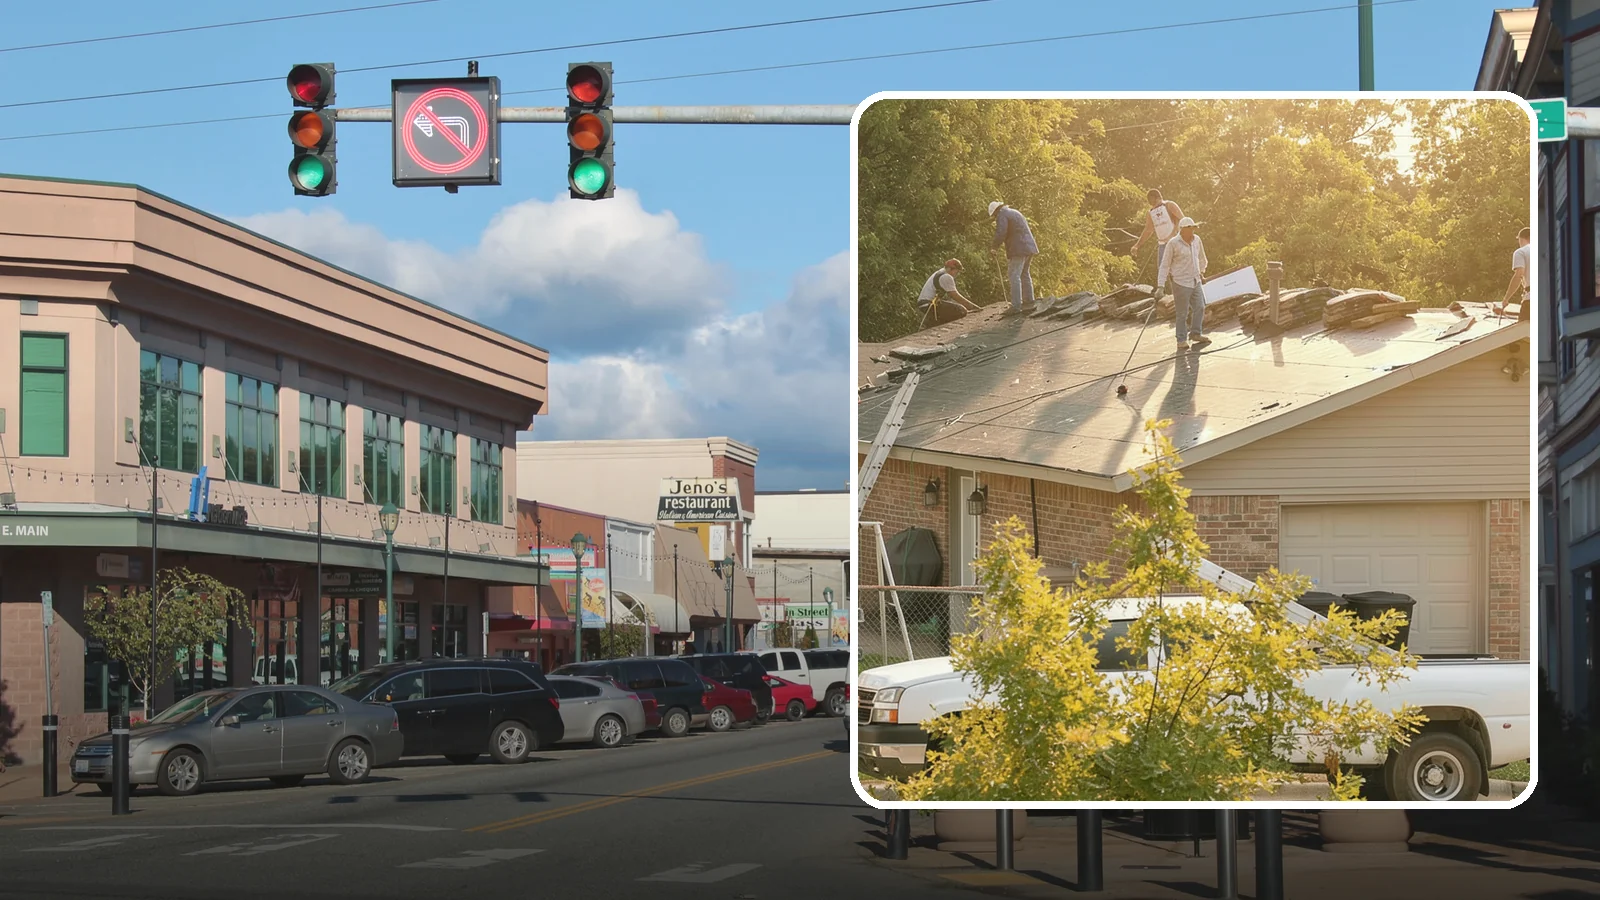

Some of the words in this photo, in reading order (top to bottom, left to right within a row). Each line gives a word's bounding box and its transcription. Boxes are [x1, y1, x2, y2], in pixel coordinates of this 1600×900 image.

[669, 480, 727, 494] Jeno's
[665, 496, 731, 509] restaurant
[658, 510, 681, 519] Italian
[686, 509, 714, 519] American
[715, 509, 738, 519] Cuisine
[2, 525, 13, 536] E.
[15, 525, 49, 536] MAIN
[785, 607, 794, 616] in
[797, 607, 828, 616] Street
